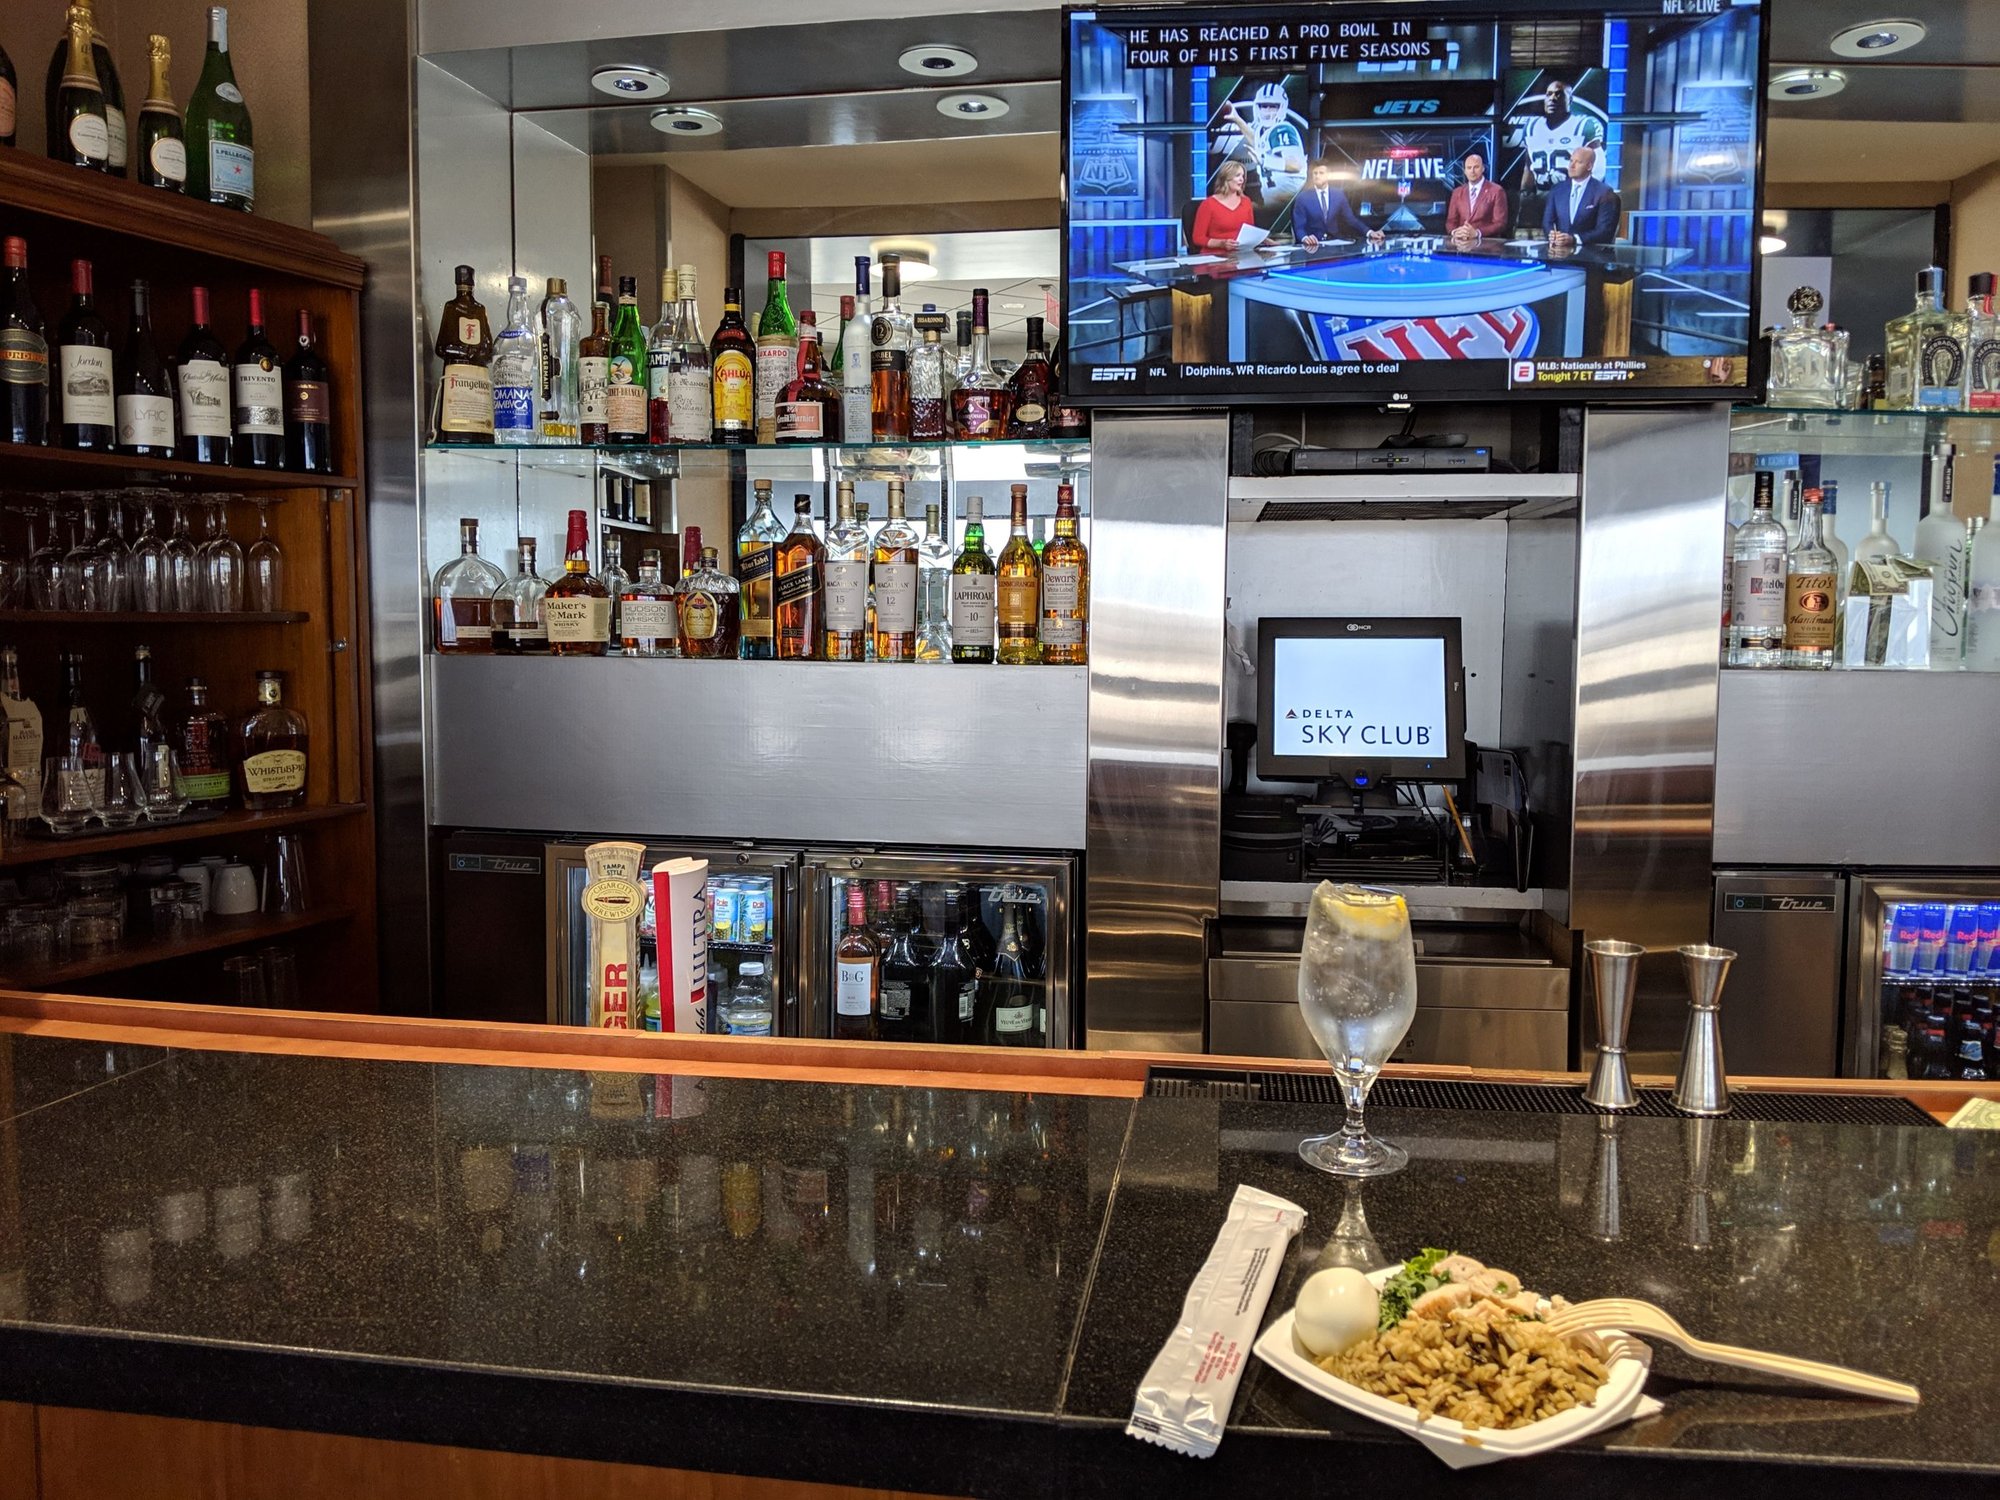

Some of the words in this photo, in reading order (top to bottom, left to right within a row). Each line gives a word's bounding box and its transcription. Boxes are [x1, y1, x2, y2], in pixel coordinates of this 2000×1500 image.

[1130, 29, 1149, 43] HE
[1159, 28, 1189, 43] HAS
[1199, 26, 1269, 42] REACHED
[1278, 25, 1290, 39] A
[1299, 23, 1330, 39] PRO
[1339, 22, 1380, 37] BOWL
[1392, 21, 1411, 36] IN
[1130, 49, 1169, 64] FOUR
[1178, 48, 1199, 63] OF
[1208, 46, 1239, 62] HIS
[1250, 45, 1299, 61] FIRST
[1309, 44, 1349, 59] FIVE
[1359, 41, 1431, 57] SEASONS
[1373, 99, 1441, 114] JETS
[1361, 158, 1398, 180] NFL
[1404, 157, 1446, 179] LIVE
[70, 354, 104, 369] Jordan
[542, 342, 550, 390] ST-GERMAIN
[1537, 362, 1559, 370] MLB:
[1560, 361, 1602, 370] Nationals
[1614, 361, 1647, 370] Phillies
[1091, 367, 1137, 382] ESPN
[1149, 367, 1167, 377] NFL
[1236, 365, 1254, 375] WR
[1256, 364, 1297, 375] Ricardo
[1299, 363, 1328, 374] Louis
[1330, 365, 1360, 376] agree
[1363, 364, 1374, 374] to
[1376, 363, 1399, 373] deal
[1537, 371, 1571, 383] Tonight
[1573, 371, 1579, 380] 7
[1580, 371, 1593, 380] ET
[239, 375, 276, 383] TRIVENTO
[450, 374, 490, 391] Frangelico
[134, 409, 168, 422] LYRIC
[1045, 573, 1076, 583] Dewar's
[1796, 576, 1834, 589] Tito's
[836, 595, 845, 604] 15
[886, 596, 896, 605] 12
[547, 602, 587, 610] Maker's
[557, 611, 586, 619] Mark
[969, 612, 979, 621] 10
[1302, 709, 1354, 719] DELTA
[1301, 724, 1352, 744] SKY
[1361, 725, 1431, 745] CLUB
[592, 882, 617, 895] CIGAR
[616, 882, 633, 894] CITY
[716, 898, 729, 907] Dole
[593, 905, 633, 918] BREWING
[692, 881, 706, 986] ULTRA
[1900, 930, 1919, 940] Red
[1923, 930, 1942, 940] Red
[1957, 930, 1977, 941] Red
